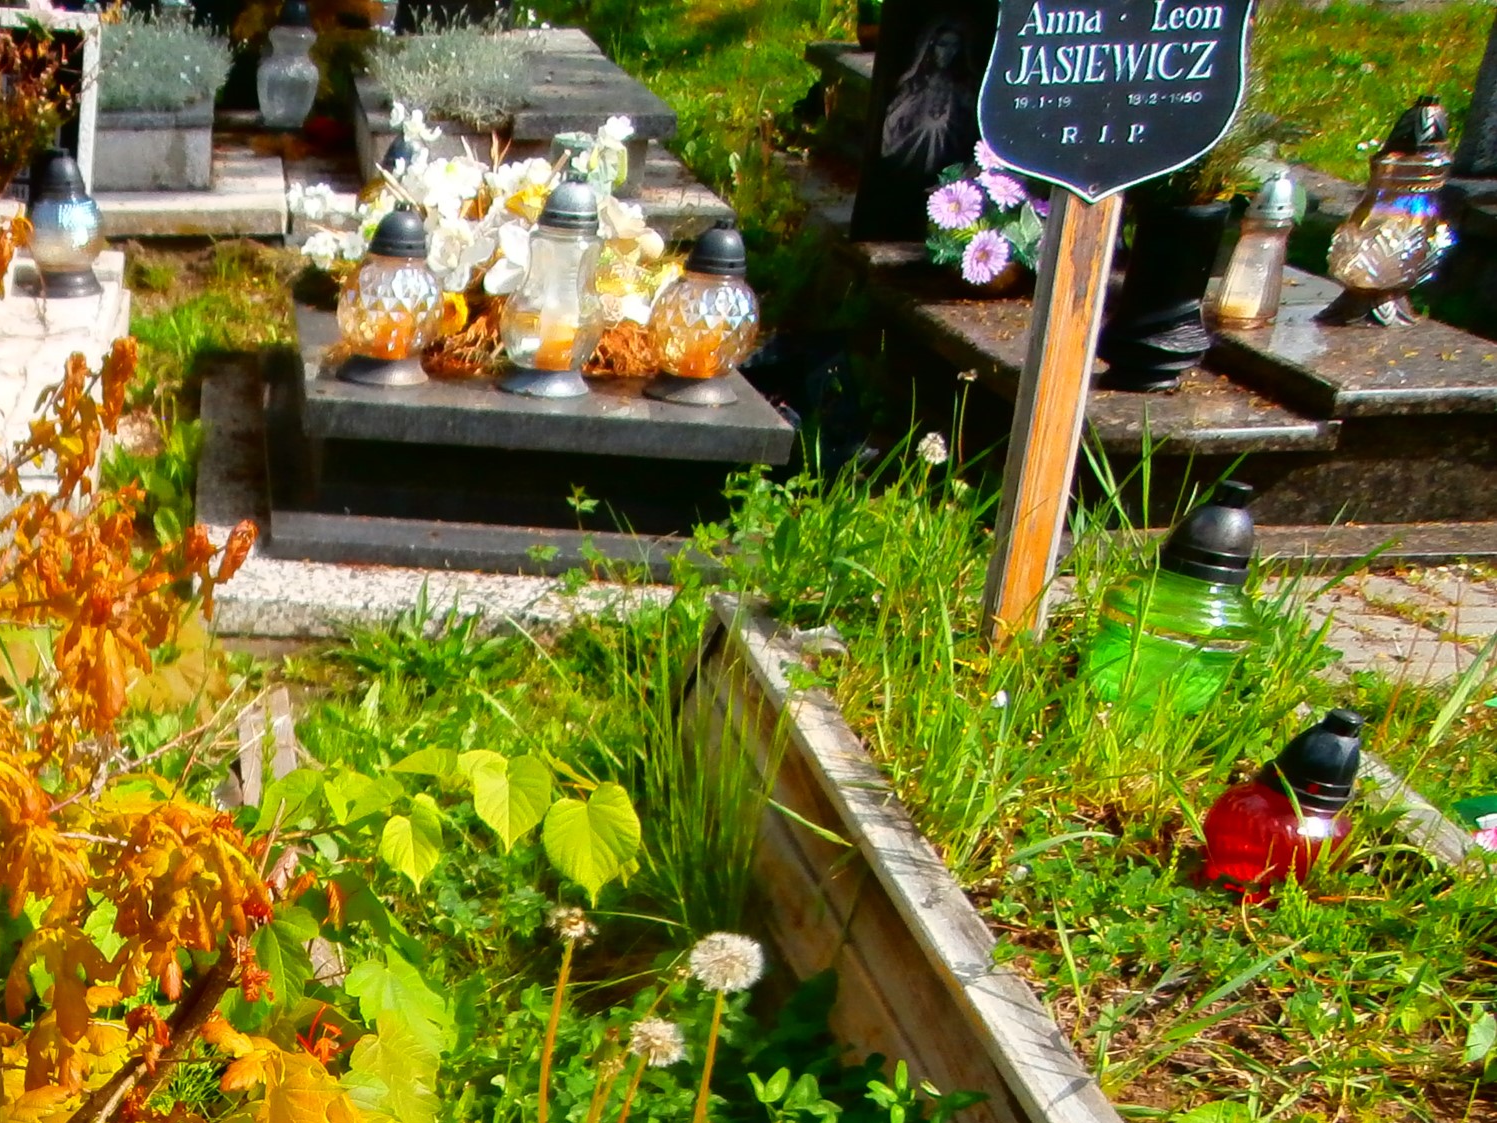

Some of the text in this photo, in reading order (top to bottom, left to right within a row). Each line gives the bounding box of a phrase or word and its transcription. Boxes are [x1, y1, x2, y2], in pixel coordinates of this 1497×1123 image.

[1017, 0, 1223, 36] Anna Leon
[1005, 40, 1218, 86] JASIEWICZ
